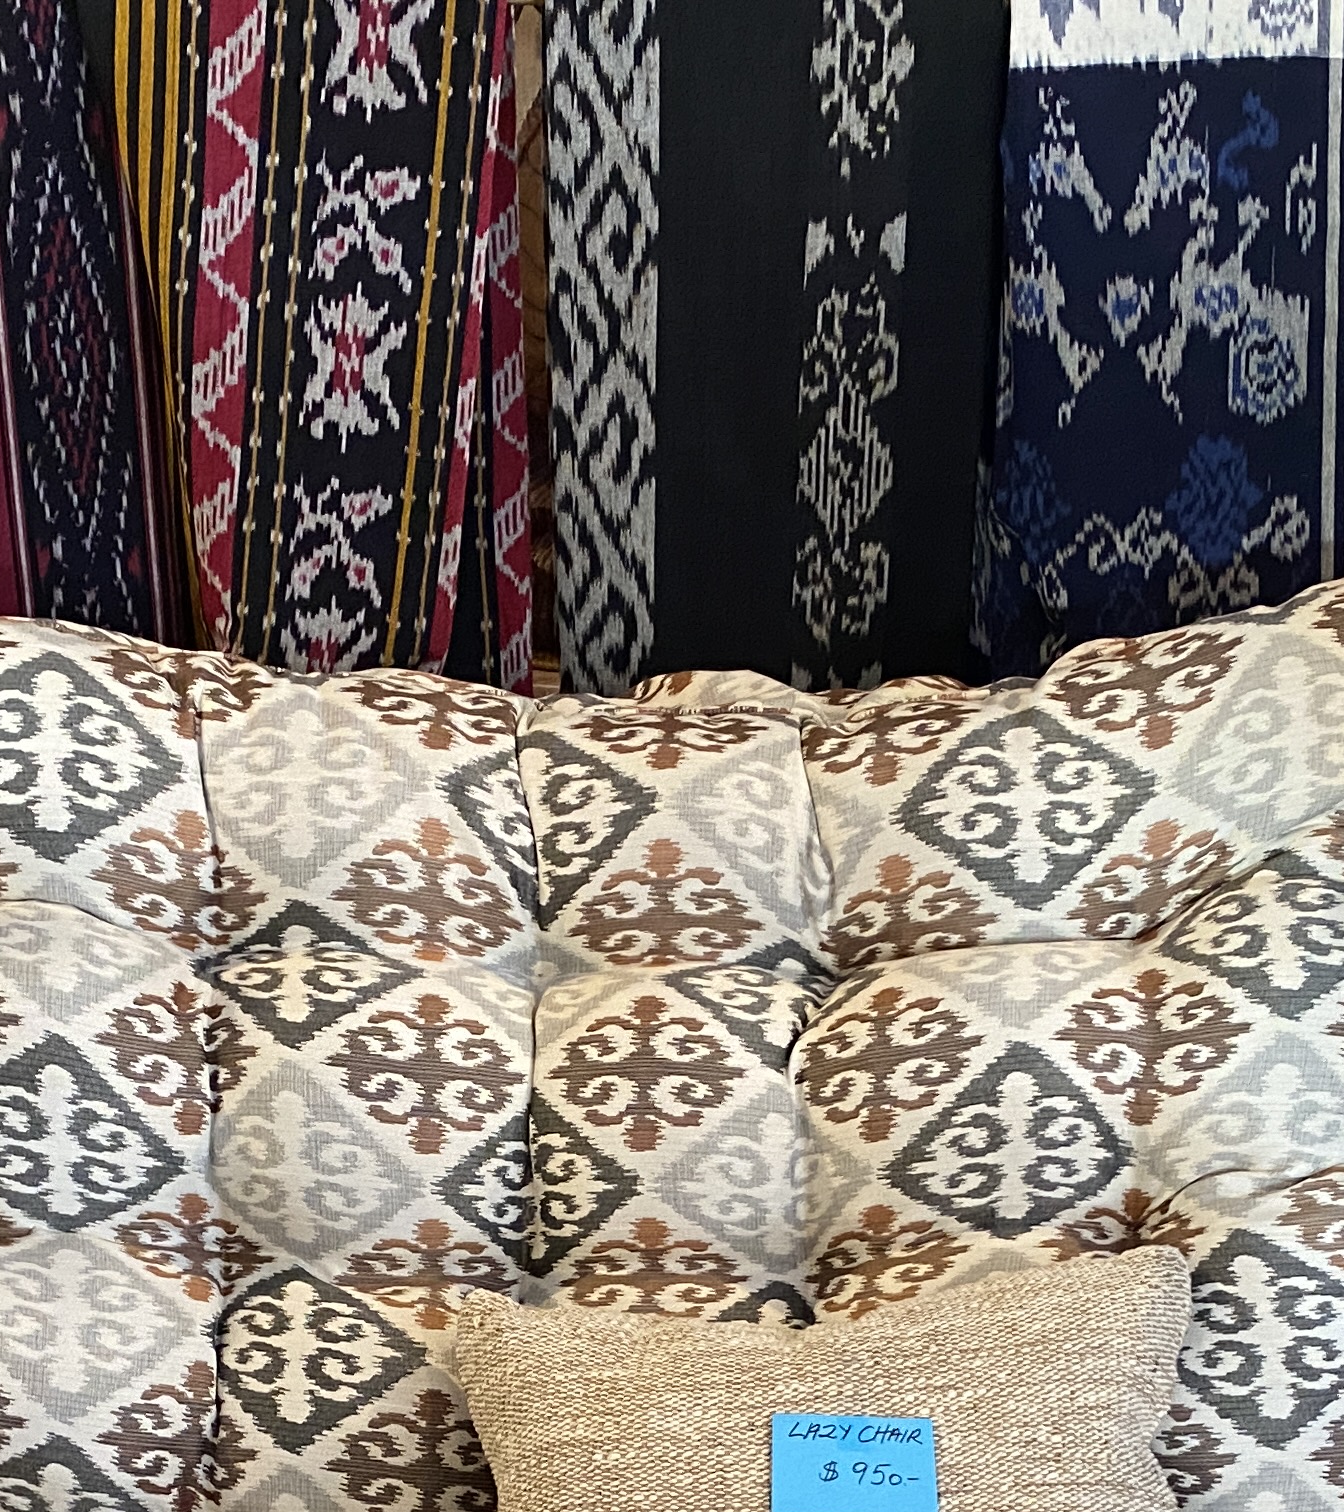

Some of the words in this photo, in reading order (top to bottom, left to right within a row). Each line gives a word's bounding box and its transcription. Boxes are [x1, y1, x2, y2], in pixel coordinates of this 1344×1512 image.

[787, 1421, 852, 1441] LAZY
[857, 1423, 924, 1445] CHAIR
[818, 1460, 839, 1482] $
